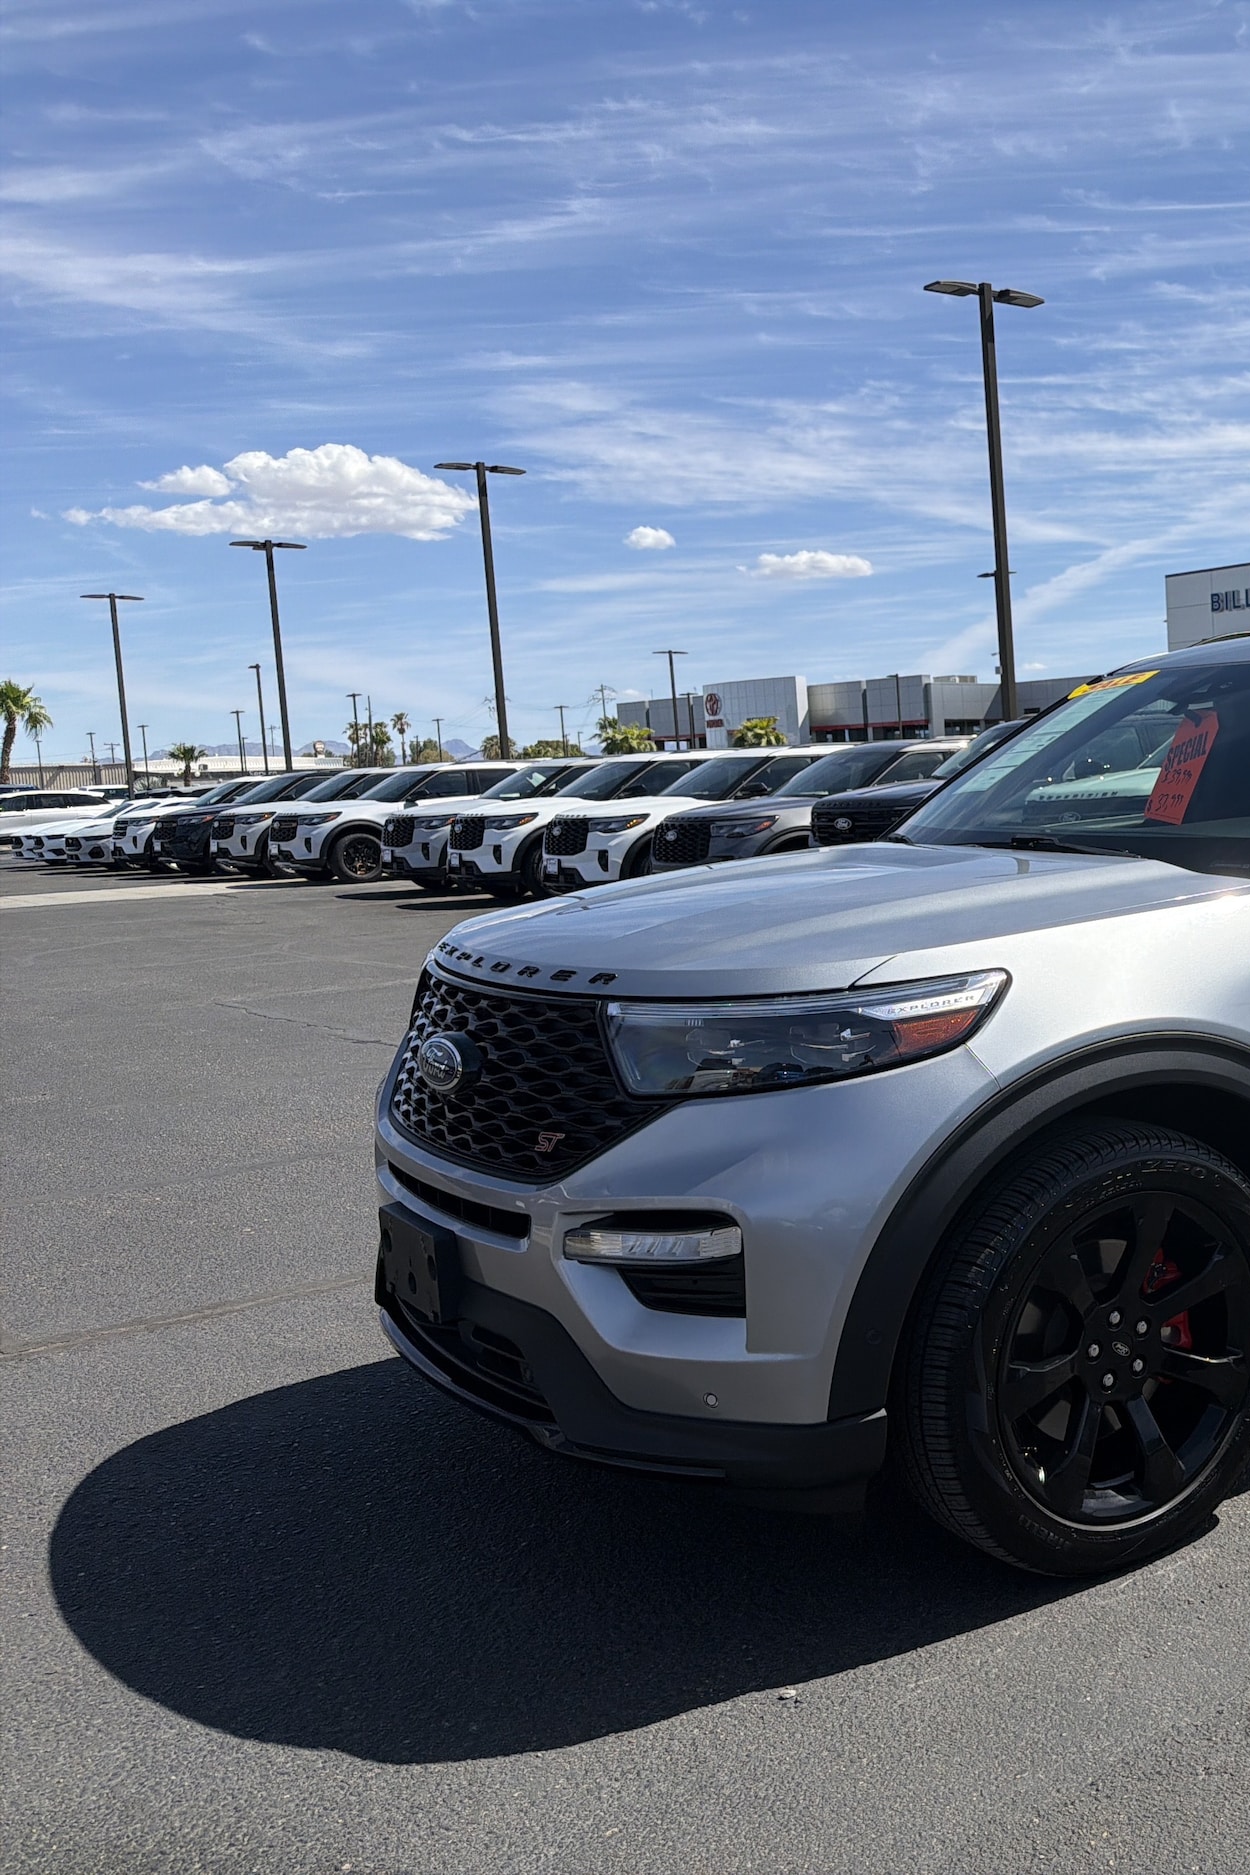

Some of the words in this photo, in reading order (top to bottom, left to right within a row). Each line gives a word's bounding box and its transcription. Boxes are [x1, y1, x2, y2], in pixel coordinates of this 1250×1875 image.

[1166, 732, 1208, 771] SPECIAL
[438, 941, 618, 985] EXPLORER
[887, 995, 975, 1015] EXPLORER
[535, 1132, 566, 1152] ST
